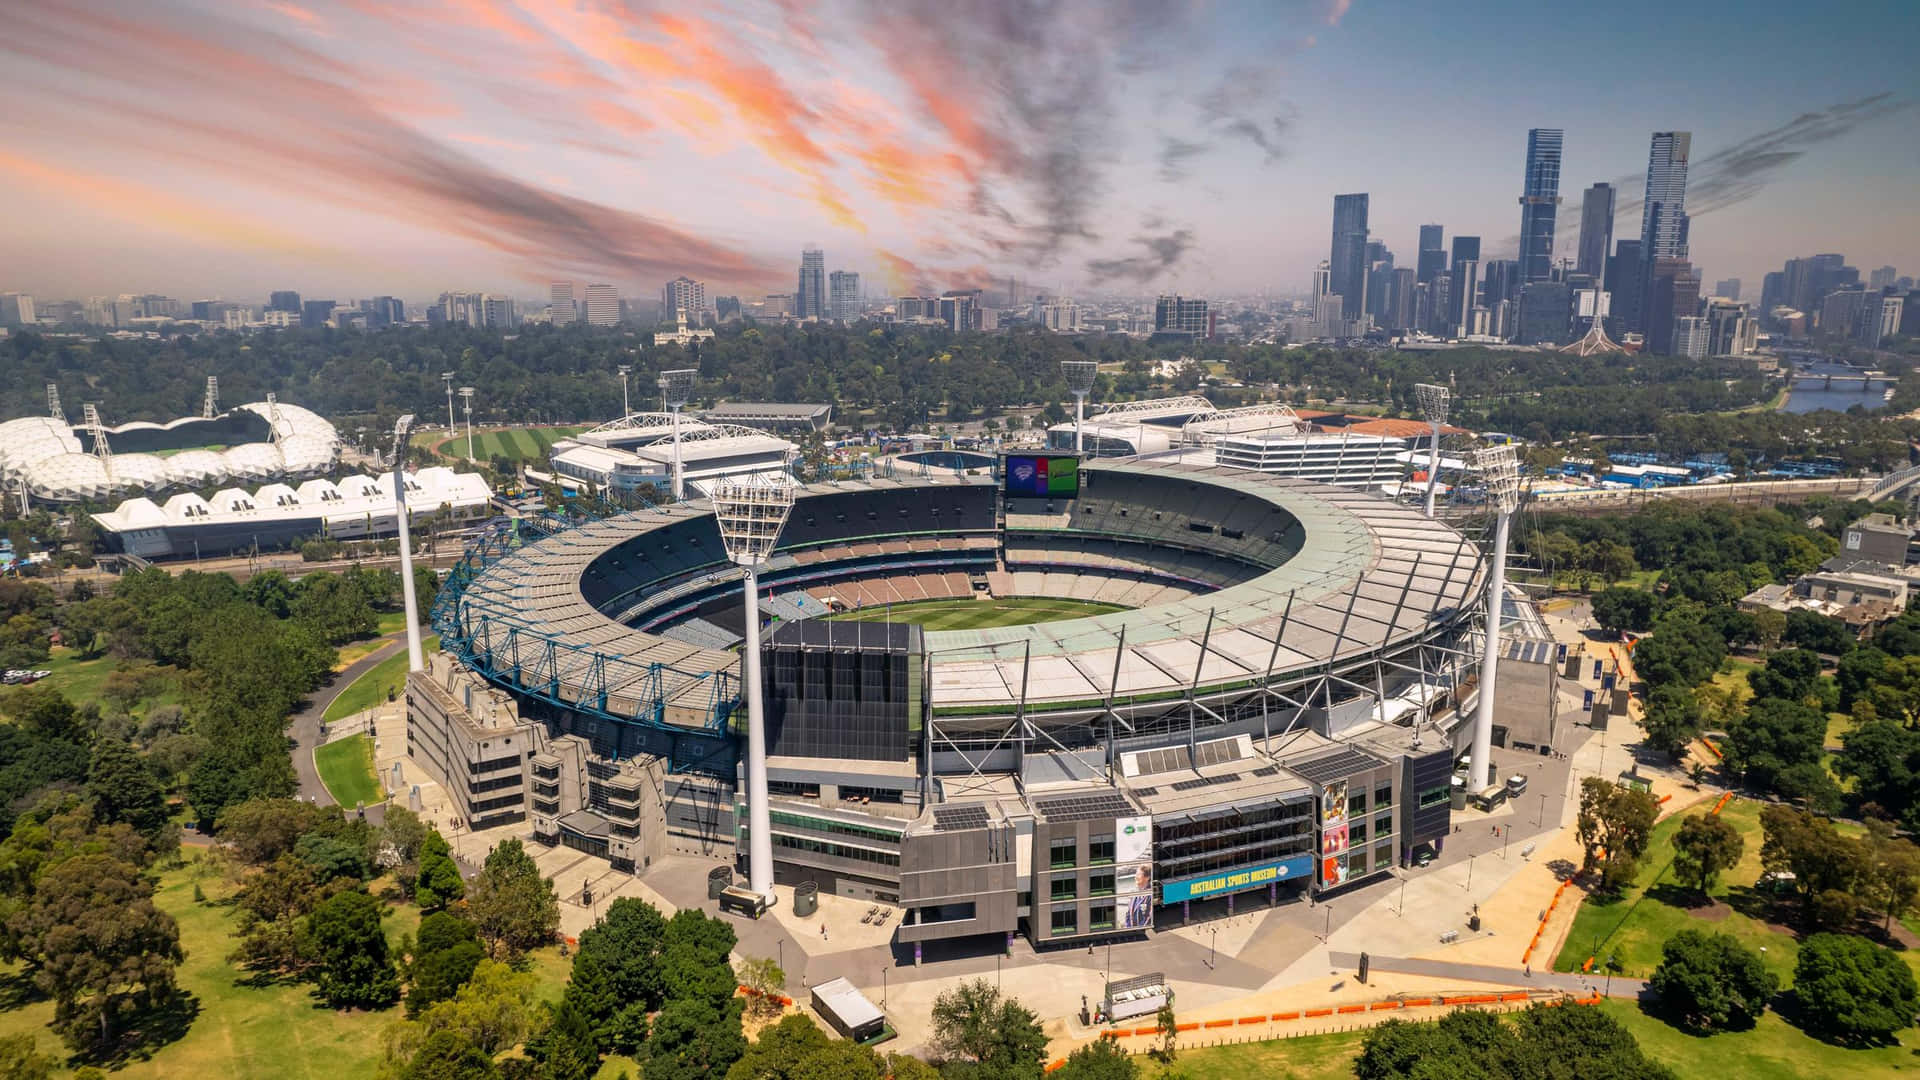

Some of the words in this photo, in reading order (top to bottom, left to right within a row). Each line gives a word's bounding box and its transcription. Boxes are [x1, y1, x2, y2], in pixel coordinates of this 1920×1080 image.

[744, 570, 752, 581] 2
[1190, 877, 1226, 895] AUSTRALIAN
[1227, 872, 1250, 888] SPORTS
[1251, 867, 1277, 882] MUSEUM
